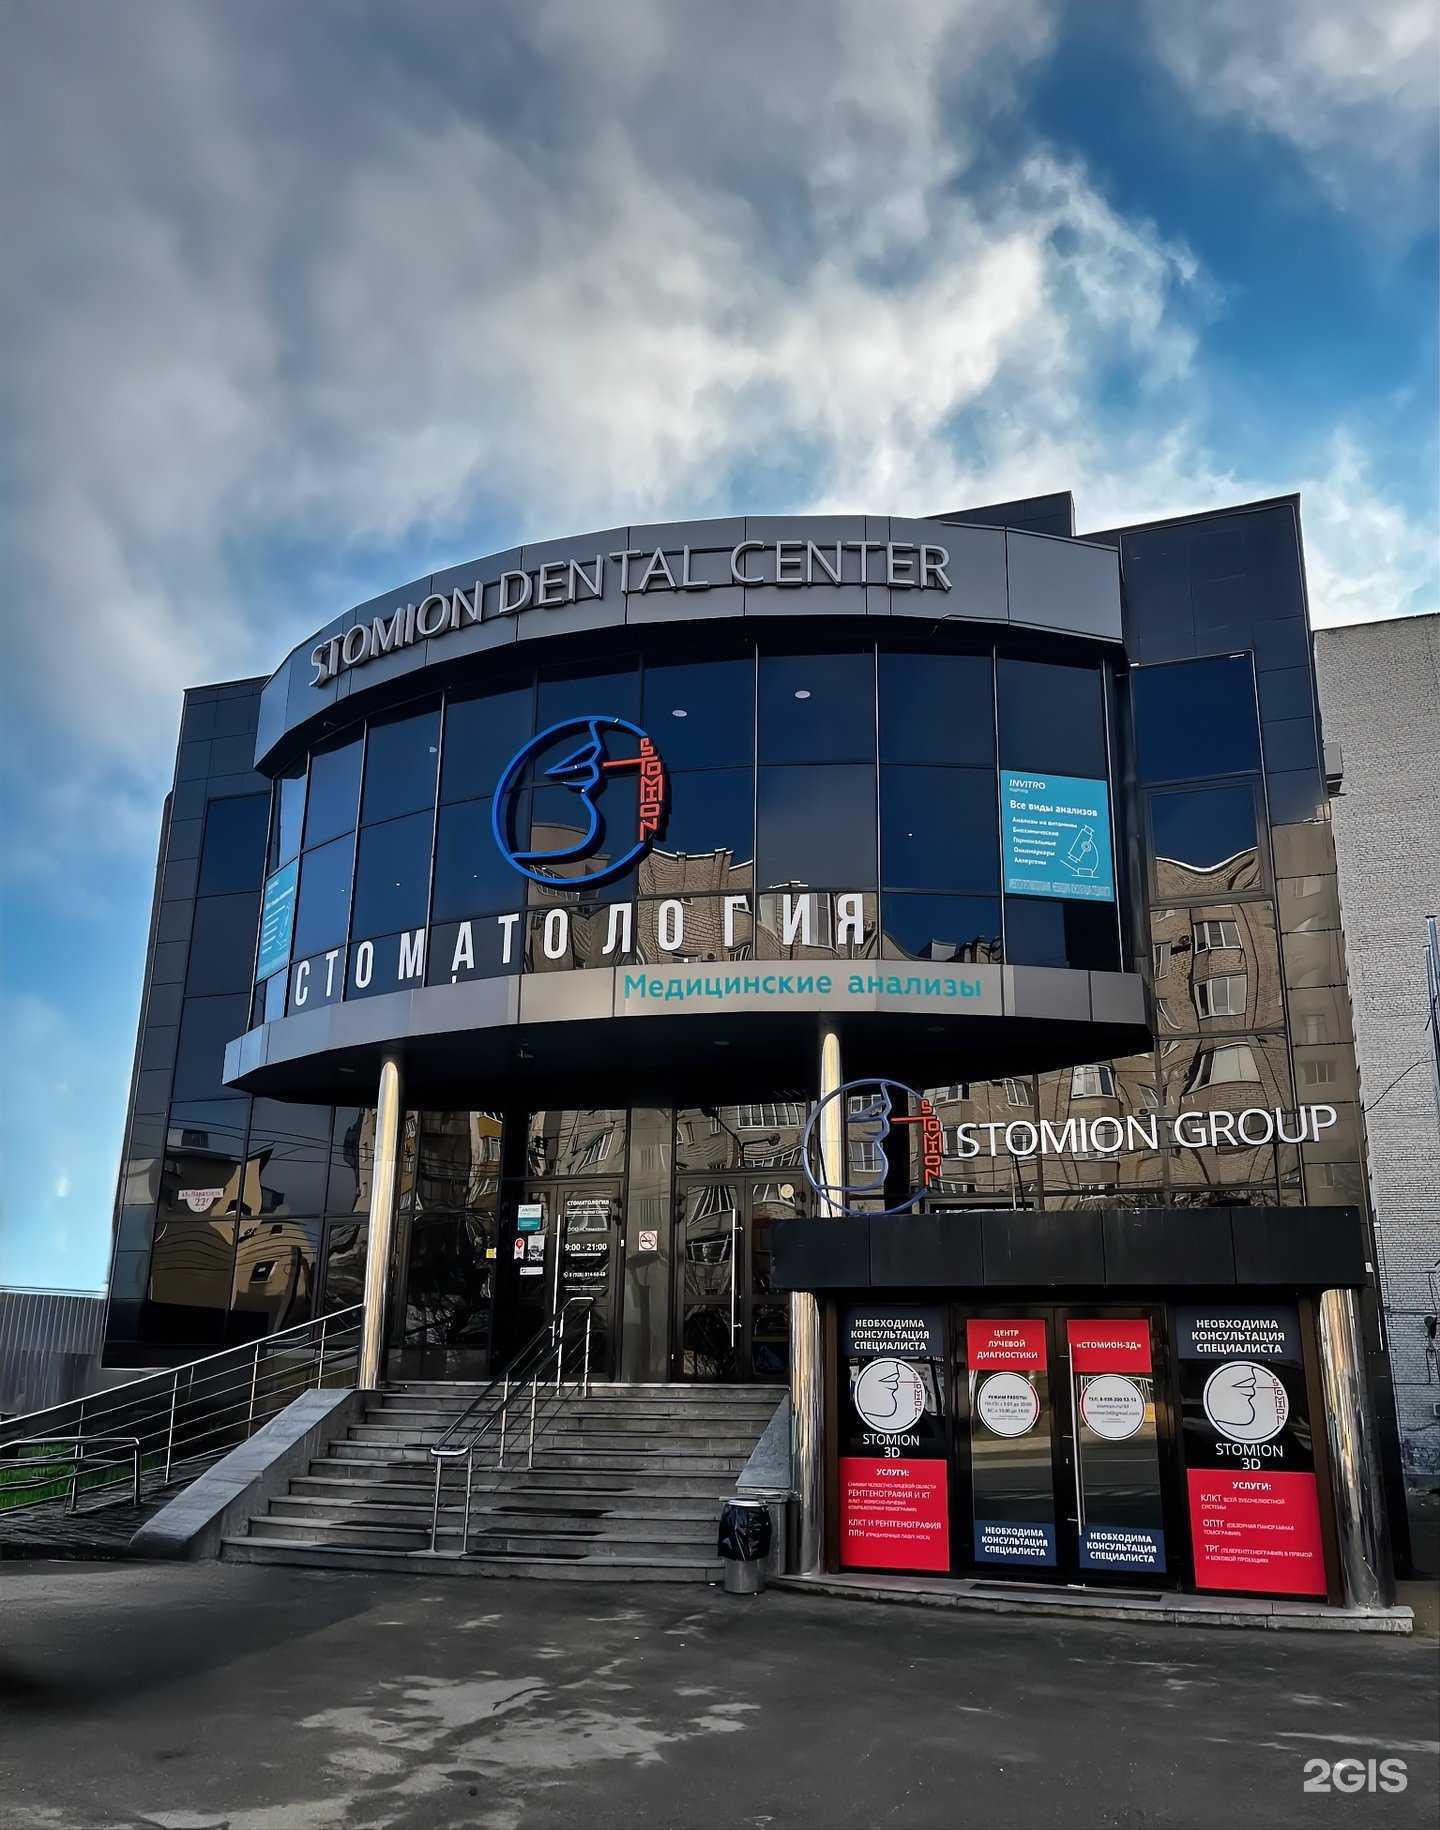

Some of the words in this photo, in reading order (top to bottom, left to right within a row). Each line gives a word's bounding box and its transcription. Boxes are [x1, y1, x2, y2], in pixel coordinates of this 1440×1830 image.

[309, 580, 485, 687] STOMION
[499, 545, 709, 615] DENTAL
[730, 540, 952, 592] CENTER
[1009, 779, 1046, 789] INVITRO
[1010, 800, 1026, 810] Все
[1028, 803, 1053, 813] виды
[1055, 807, 1098, 817] анализов
[294, 892, 864, 1007] СТОМАТОЛОГИЯ
[623, 973, 833, 1000] Медицинские
[847, 973, 982, 998] анализы
[956, 1113, 1159, 1158] STOMION
[1174, 1104, 1338, 1148] GROUP
[565, 1243, 581, 1251] 9:00
[586, 1243, 607, 1251] 21:00
[855, 1319, 925, 1330] НЕОБХОДИМА
[1196, 1319, 1279, 1330] НЕОБХОДИМА
[850, 1330, 930, 1340] КОНСУЛЬТАЦИЯ
[994, 1329, 1020, 1338] ЦЕНТР
[1191, 1331, 1285, 1342] КОНСУЛЬТАЦИЯ
[854, 1341, 927, 1351] СПЕЦИАЛИСТА
[988, 1339, 1026, 1348] ЛУЧЕВОЙ
[1196, 1343, 1283, 1354] СПЕЦИАЛИСТА
[977, 1351, 1038, 1359] ДИАГНОСТИКИ
[862, 1433, 920, 1446] STOMION
[884, 1447, 900, 1458] 3D
[1215, 1442, 1284, 1457] STOMION
[1241, 1458, 1261, 1470] 3D
[876, 1468, 910, 1477] УСЛУГИ:
[1232, 1481, 1272, 1490] УСЛУГИ:
[848, 1489, 913, 1499] РЕНТГЕНОГРАФИЯ
[921, 1491, 931, 1499] КТ
[1200, 1494, 1222, 1502] КЛКТ
[868, 1519, 875, 1527] И
[875, 1520, 941, 1530] РЕНТГЕНОГРАФИЯ
[985, 1526, 1044, 1537] НЕОБХОДИМА
[981, 1536, 1048, 1547] КОНСУЛЬТАЦИЯ
[1090, 1532, 1152, 1543] НЕОБХОДИМА
[984, 1545, 1046, 1556] СПЕЦИАЛИСТА
[1087, 1542, 1157, 1553] КОНСУЛЬТАЦИЯ
[1204, 1544, 1220, 1553] ТРГ
[1090, 1551, 1155, 1563] СПЕЦИАЛИСТА
